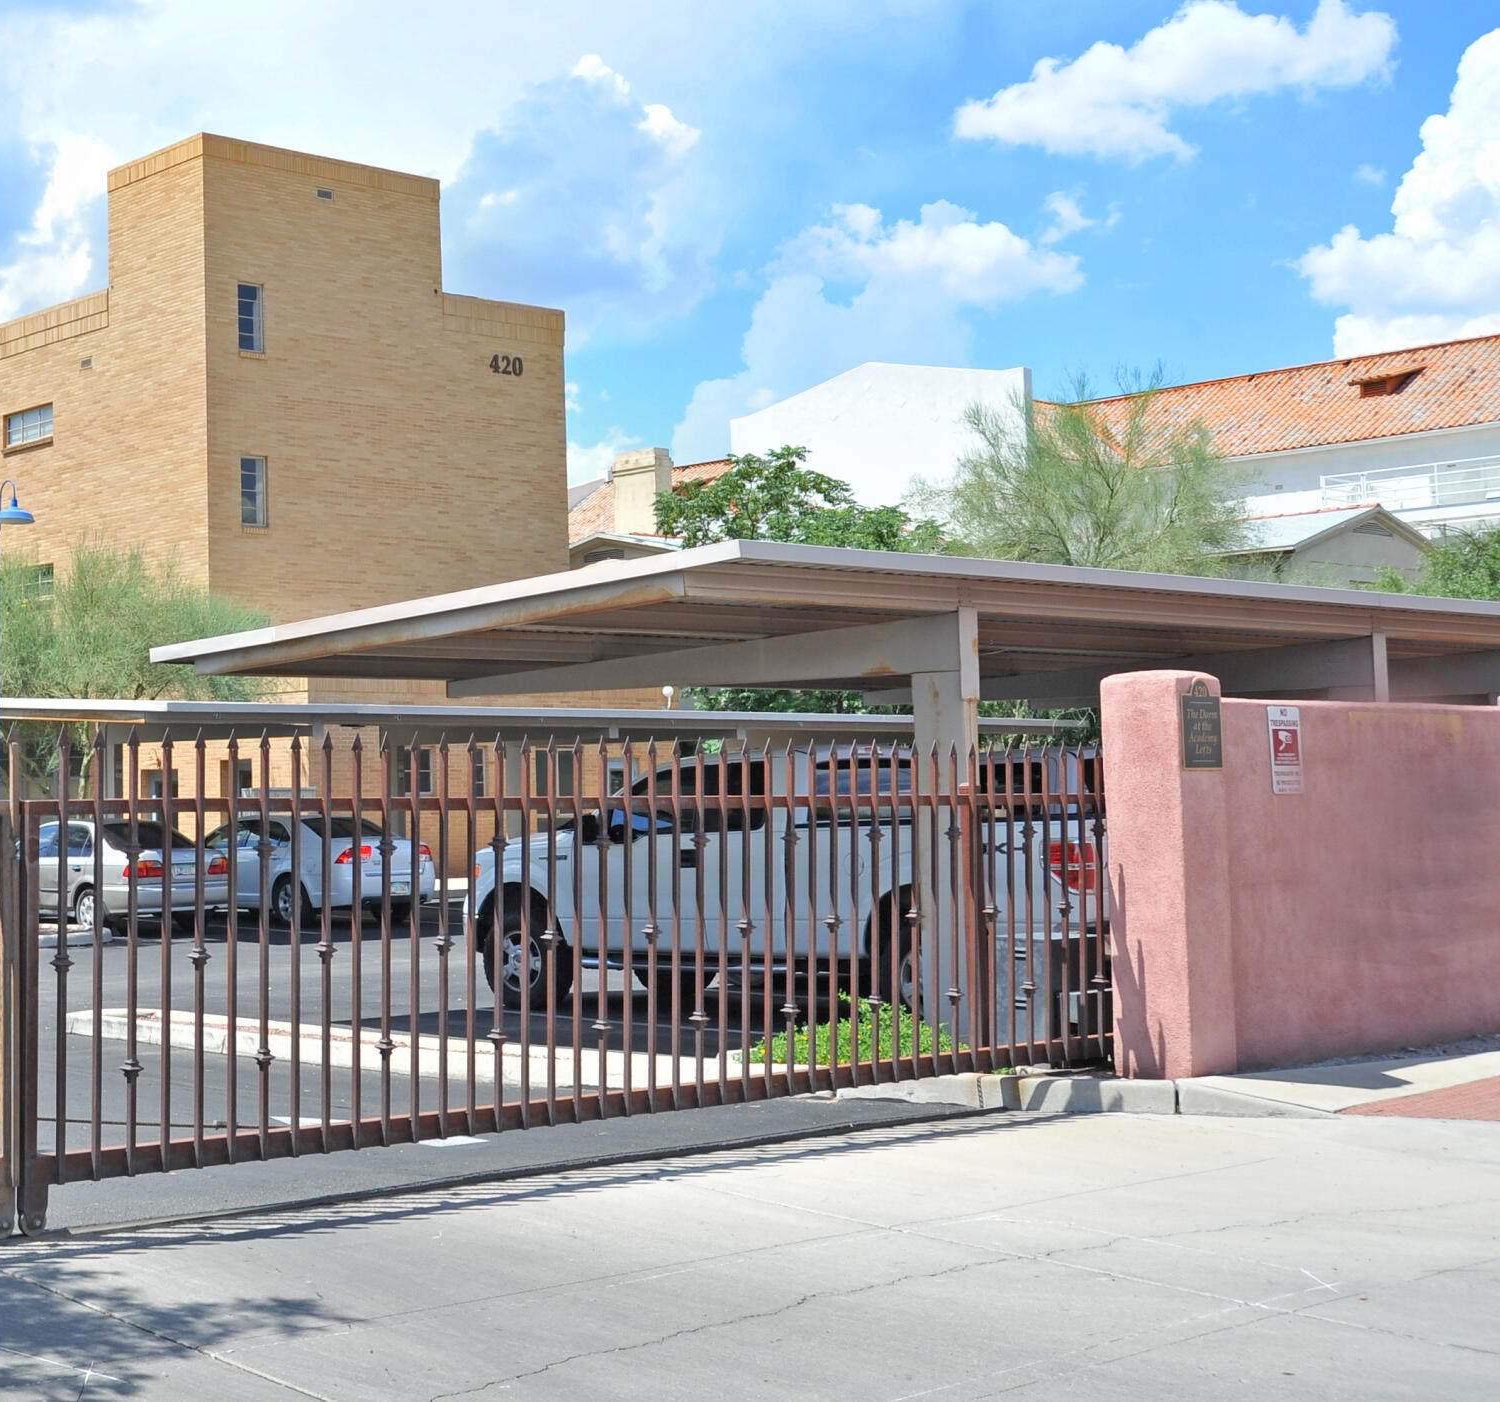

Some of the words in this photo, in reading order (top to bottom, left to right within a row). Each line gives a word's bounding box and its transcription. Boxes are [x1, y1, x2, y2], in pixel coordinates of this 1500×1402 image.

[489, 354, 524, 377] 420
[1193, 686, 1208, 697] 420
[1187, 709, 1199, 719] The
[1188, 732, 1218, 746] Academy
[1195, 744, 1212, 757] Lofts
